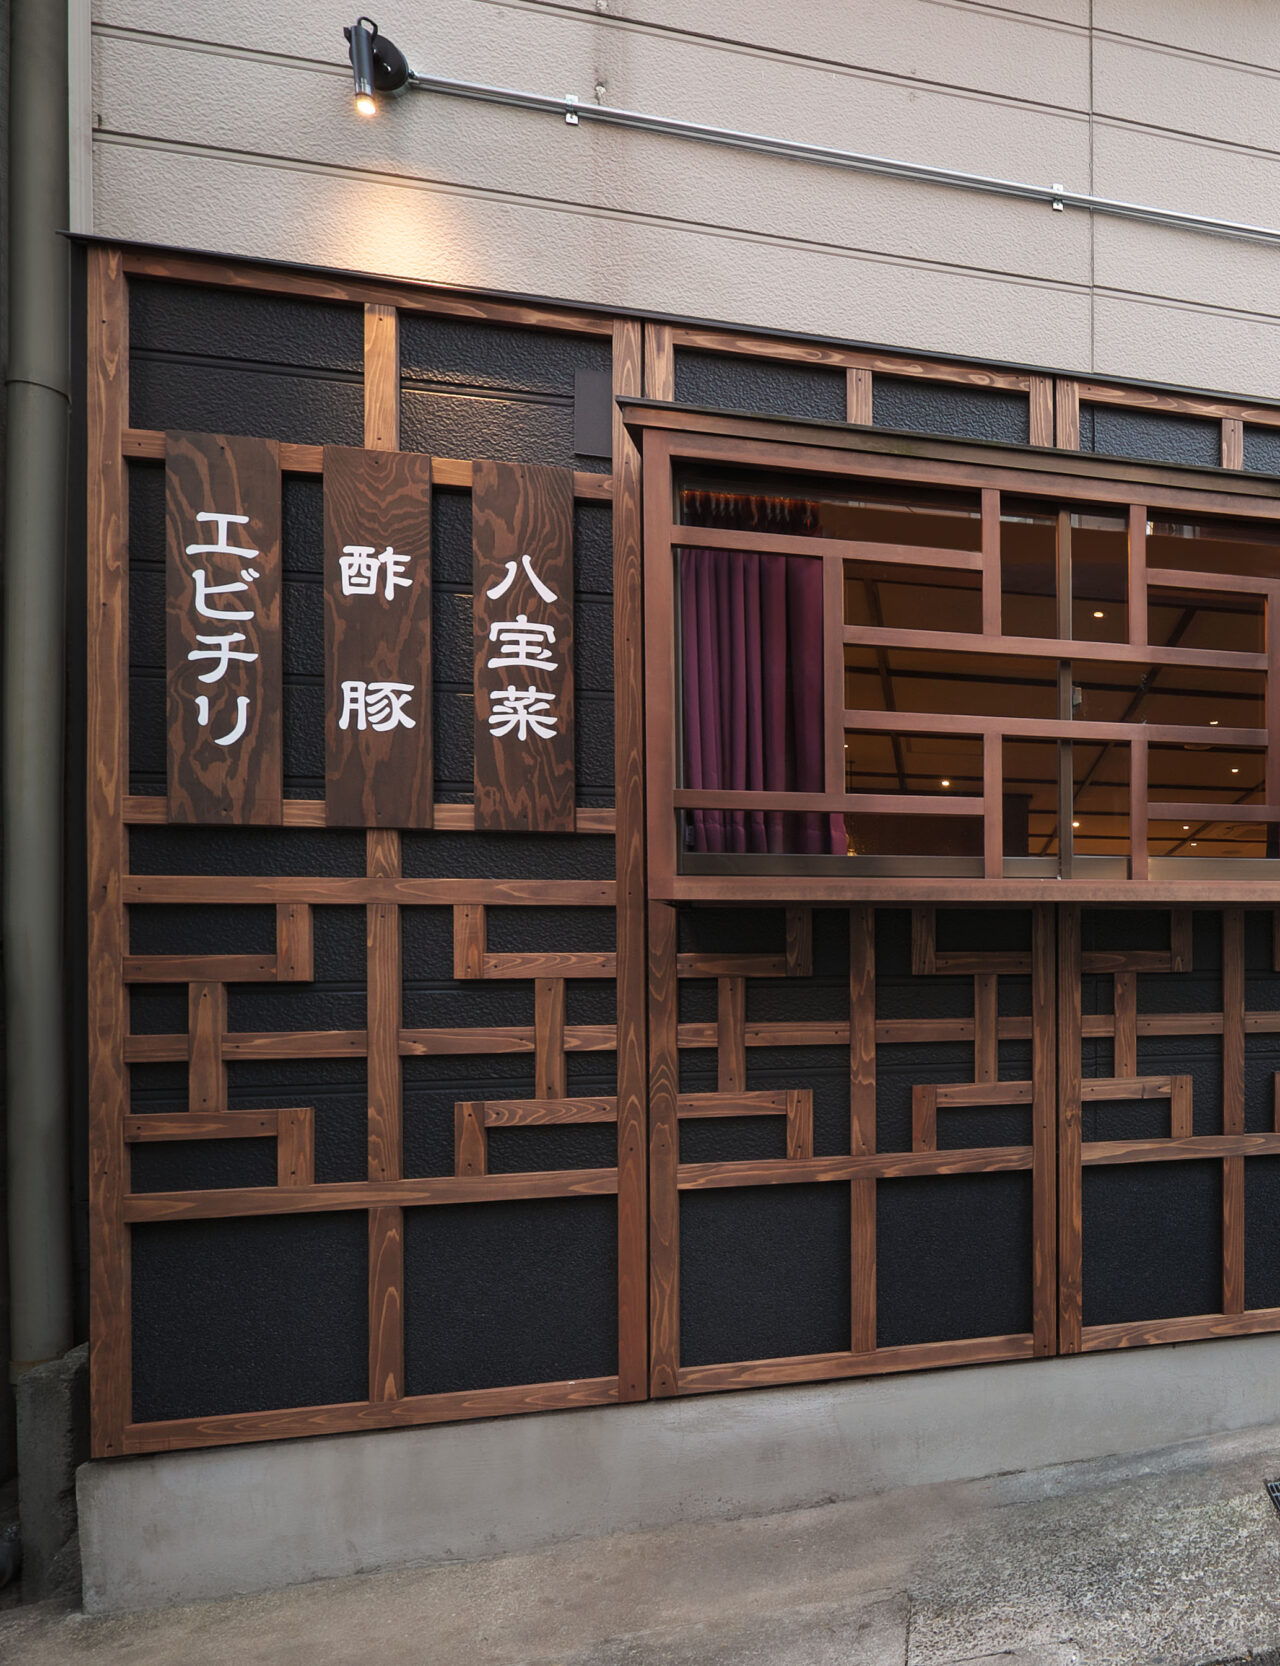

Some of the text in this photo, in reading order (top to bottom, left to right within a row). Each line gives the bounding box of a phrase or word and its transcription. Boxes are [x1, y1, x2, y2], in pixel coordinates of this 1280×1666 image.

[185, 511, 261, 746] エビチリ
[338, 545, 417, 732] 酢豚
[486, 554, 559, 742] 八宝菜
